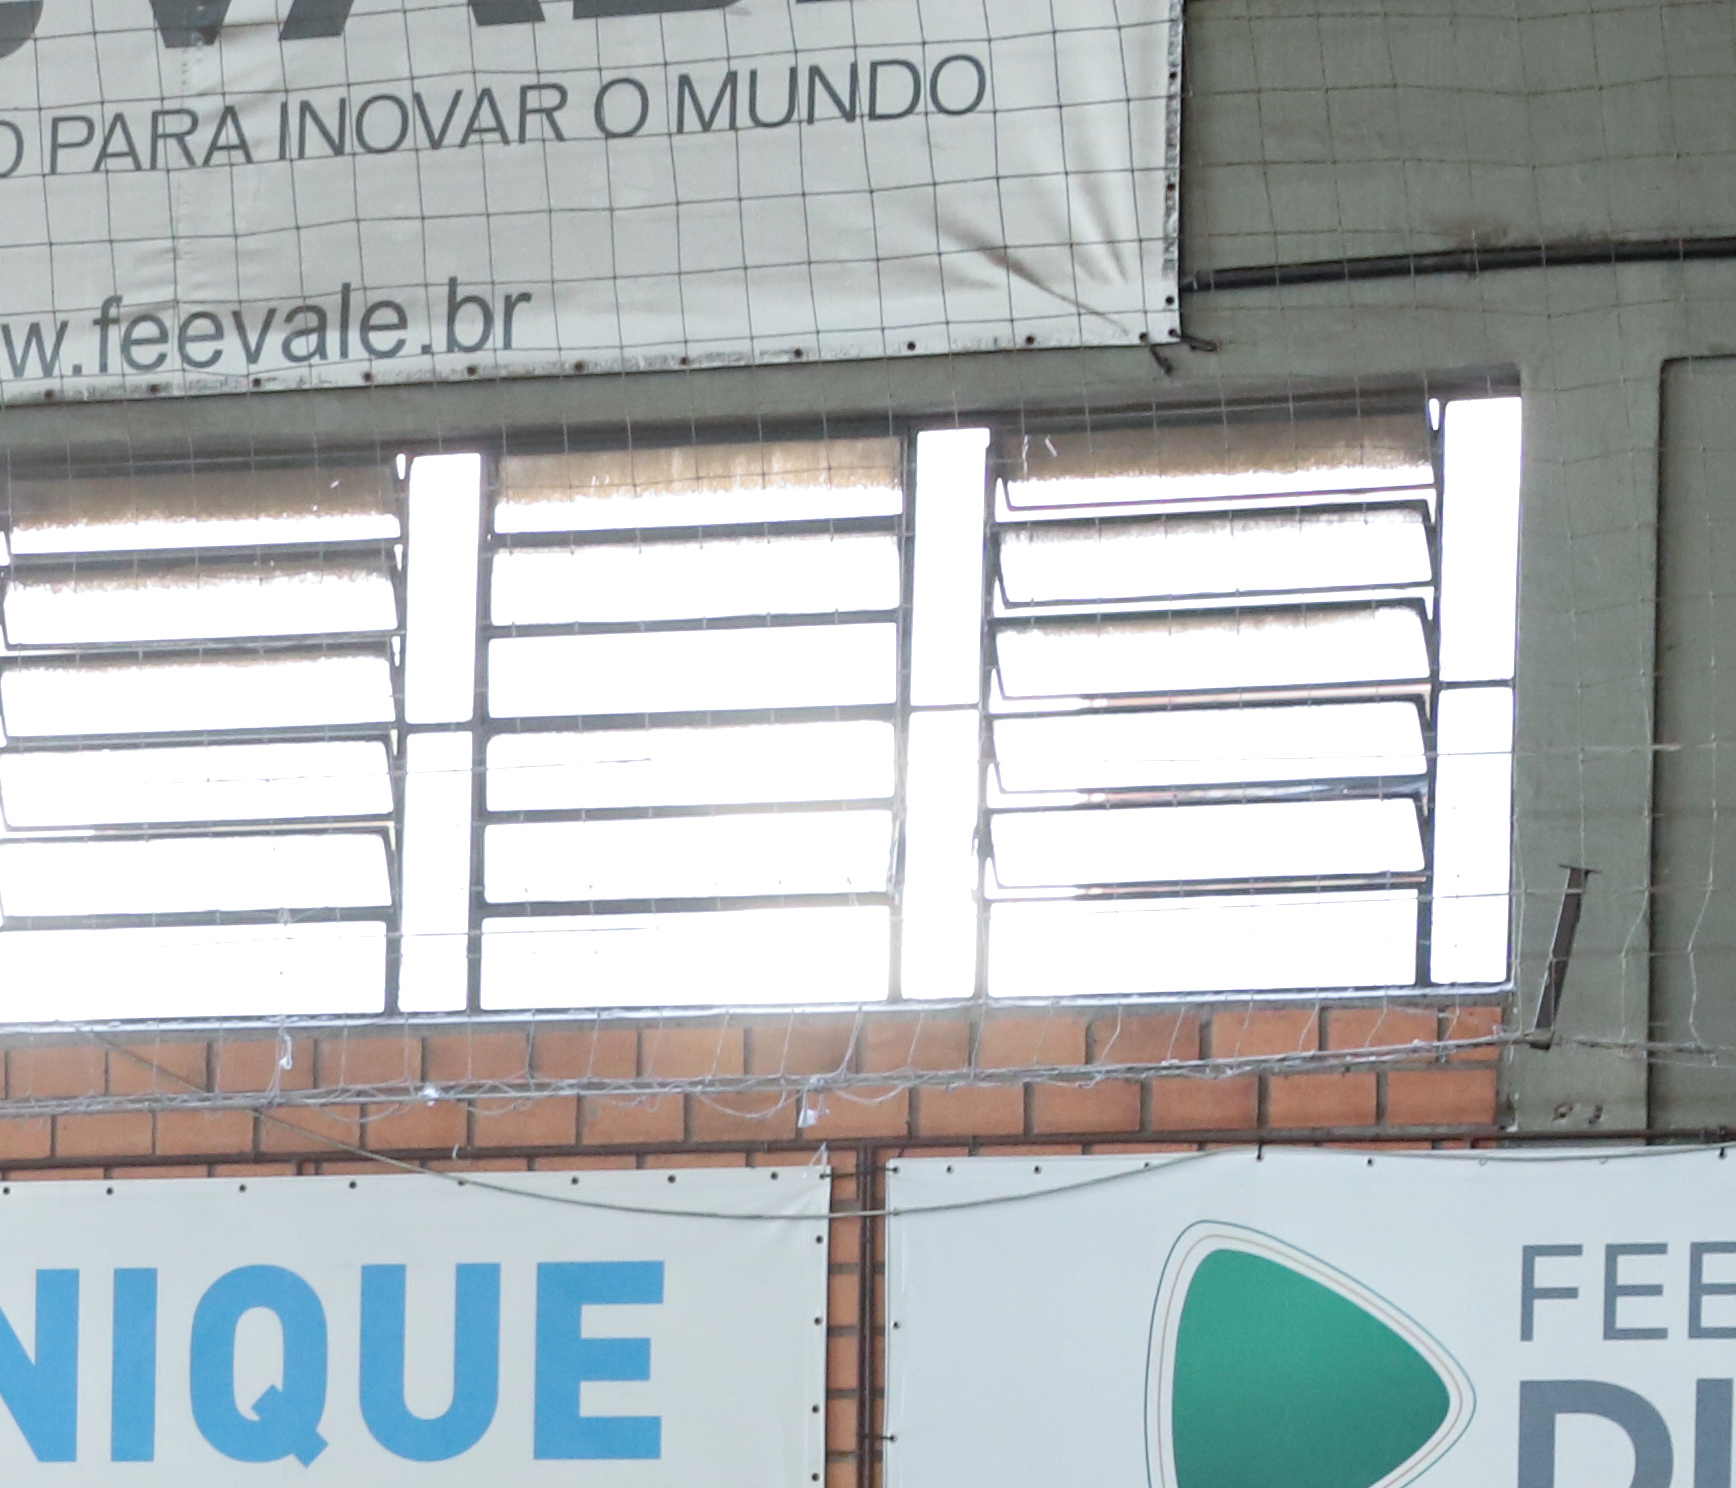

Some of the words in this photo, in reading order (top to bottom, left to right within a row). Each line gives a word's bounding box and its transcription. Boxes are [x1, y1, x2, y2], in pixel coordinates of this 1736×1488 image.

[48, 104, 254, 175] PARA
[278, 80, 568, 161] INOVAR
[593, 77, 650, 140] O
[675, 54, 987, 135] MUNDO
[1520, 1242, 1736, 1341] FEE
